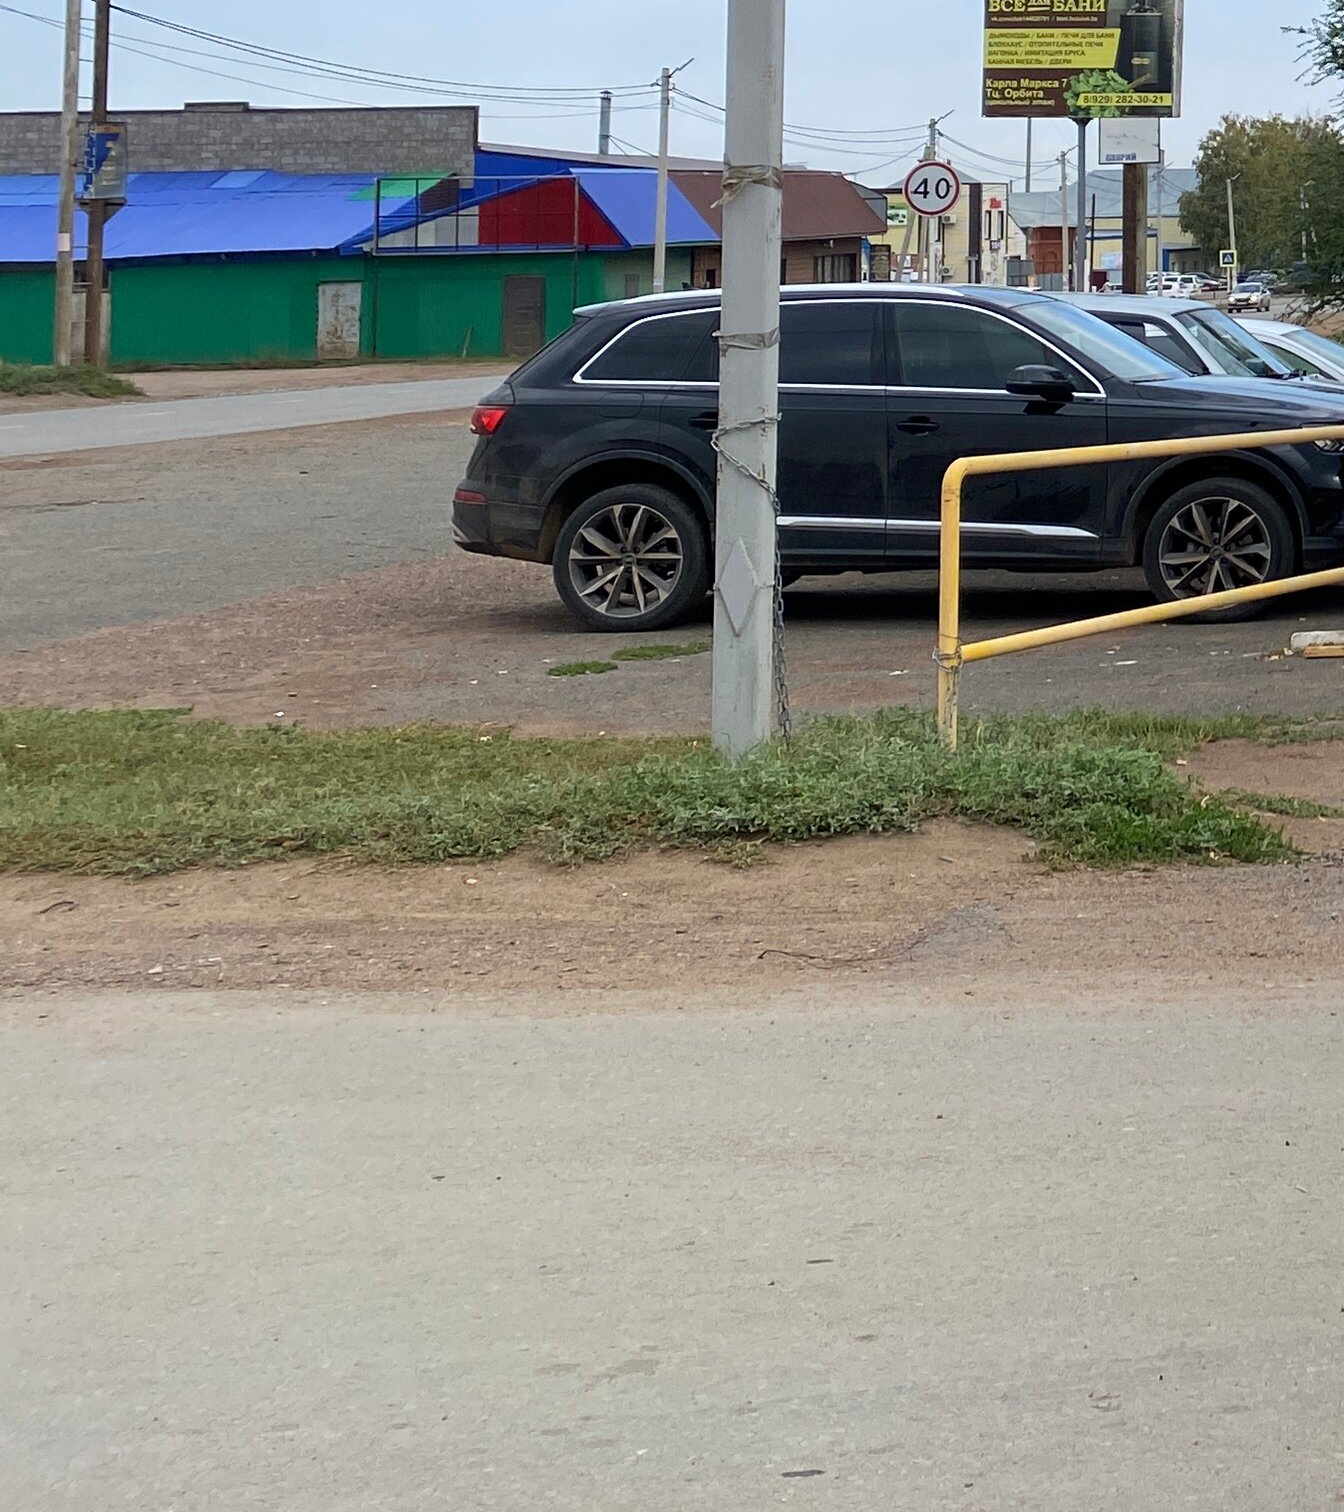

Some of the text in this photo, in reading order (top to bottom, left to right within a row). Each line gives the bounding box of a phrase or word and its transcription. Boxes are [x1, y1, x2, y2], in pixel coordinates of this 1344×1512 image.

[985, 78, 1067, 89] Карла Маркса 7
[1004, 88, 1043, 99] Орбита
[1083, 95, 1163, 104] 8(929) 282-30-21
[912, 177, 951, 200] 40
